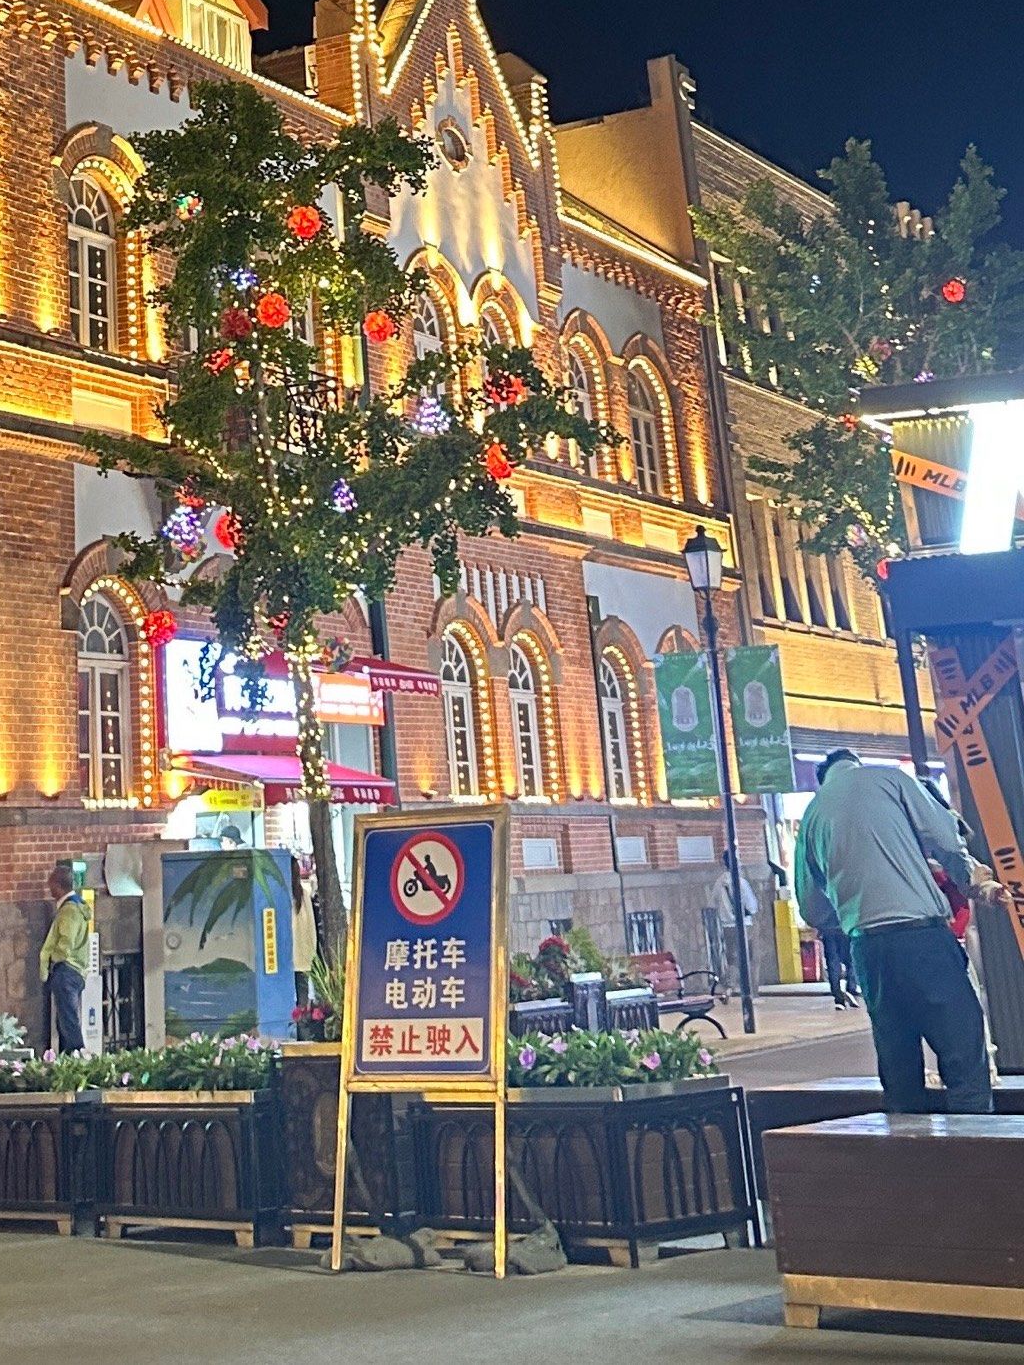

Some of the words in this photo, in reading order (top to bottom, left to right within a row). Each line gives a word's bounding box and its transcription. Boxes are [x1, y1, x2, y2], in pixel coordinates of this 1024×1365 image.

[922, 468, 966, 492] MLB
[959, 673, 995, 715] MLB
[384, 937, 466, 971] 摩托车
[385, 976, 465, 1009] 电动车
[369, 1024, 480, 1056] 禁止驶入
